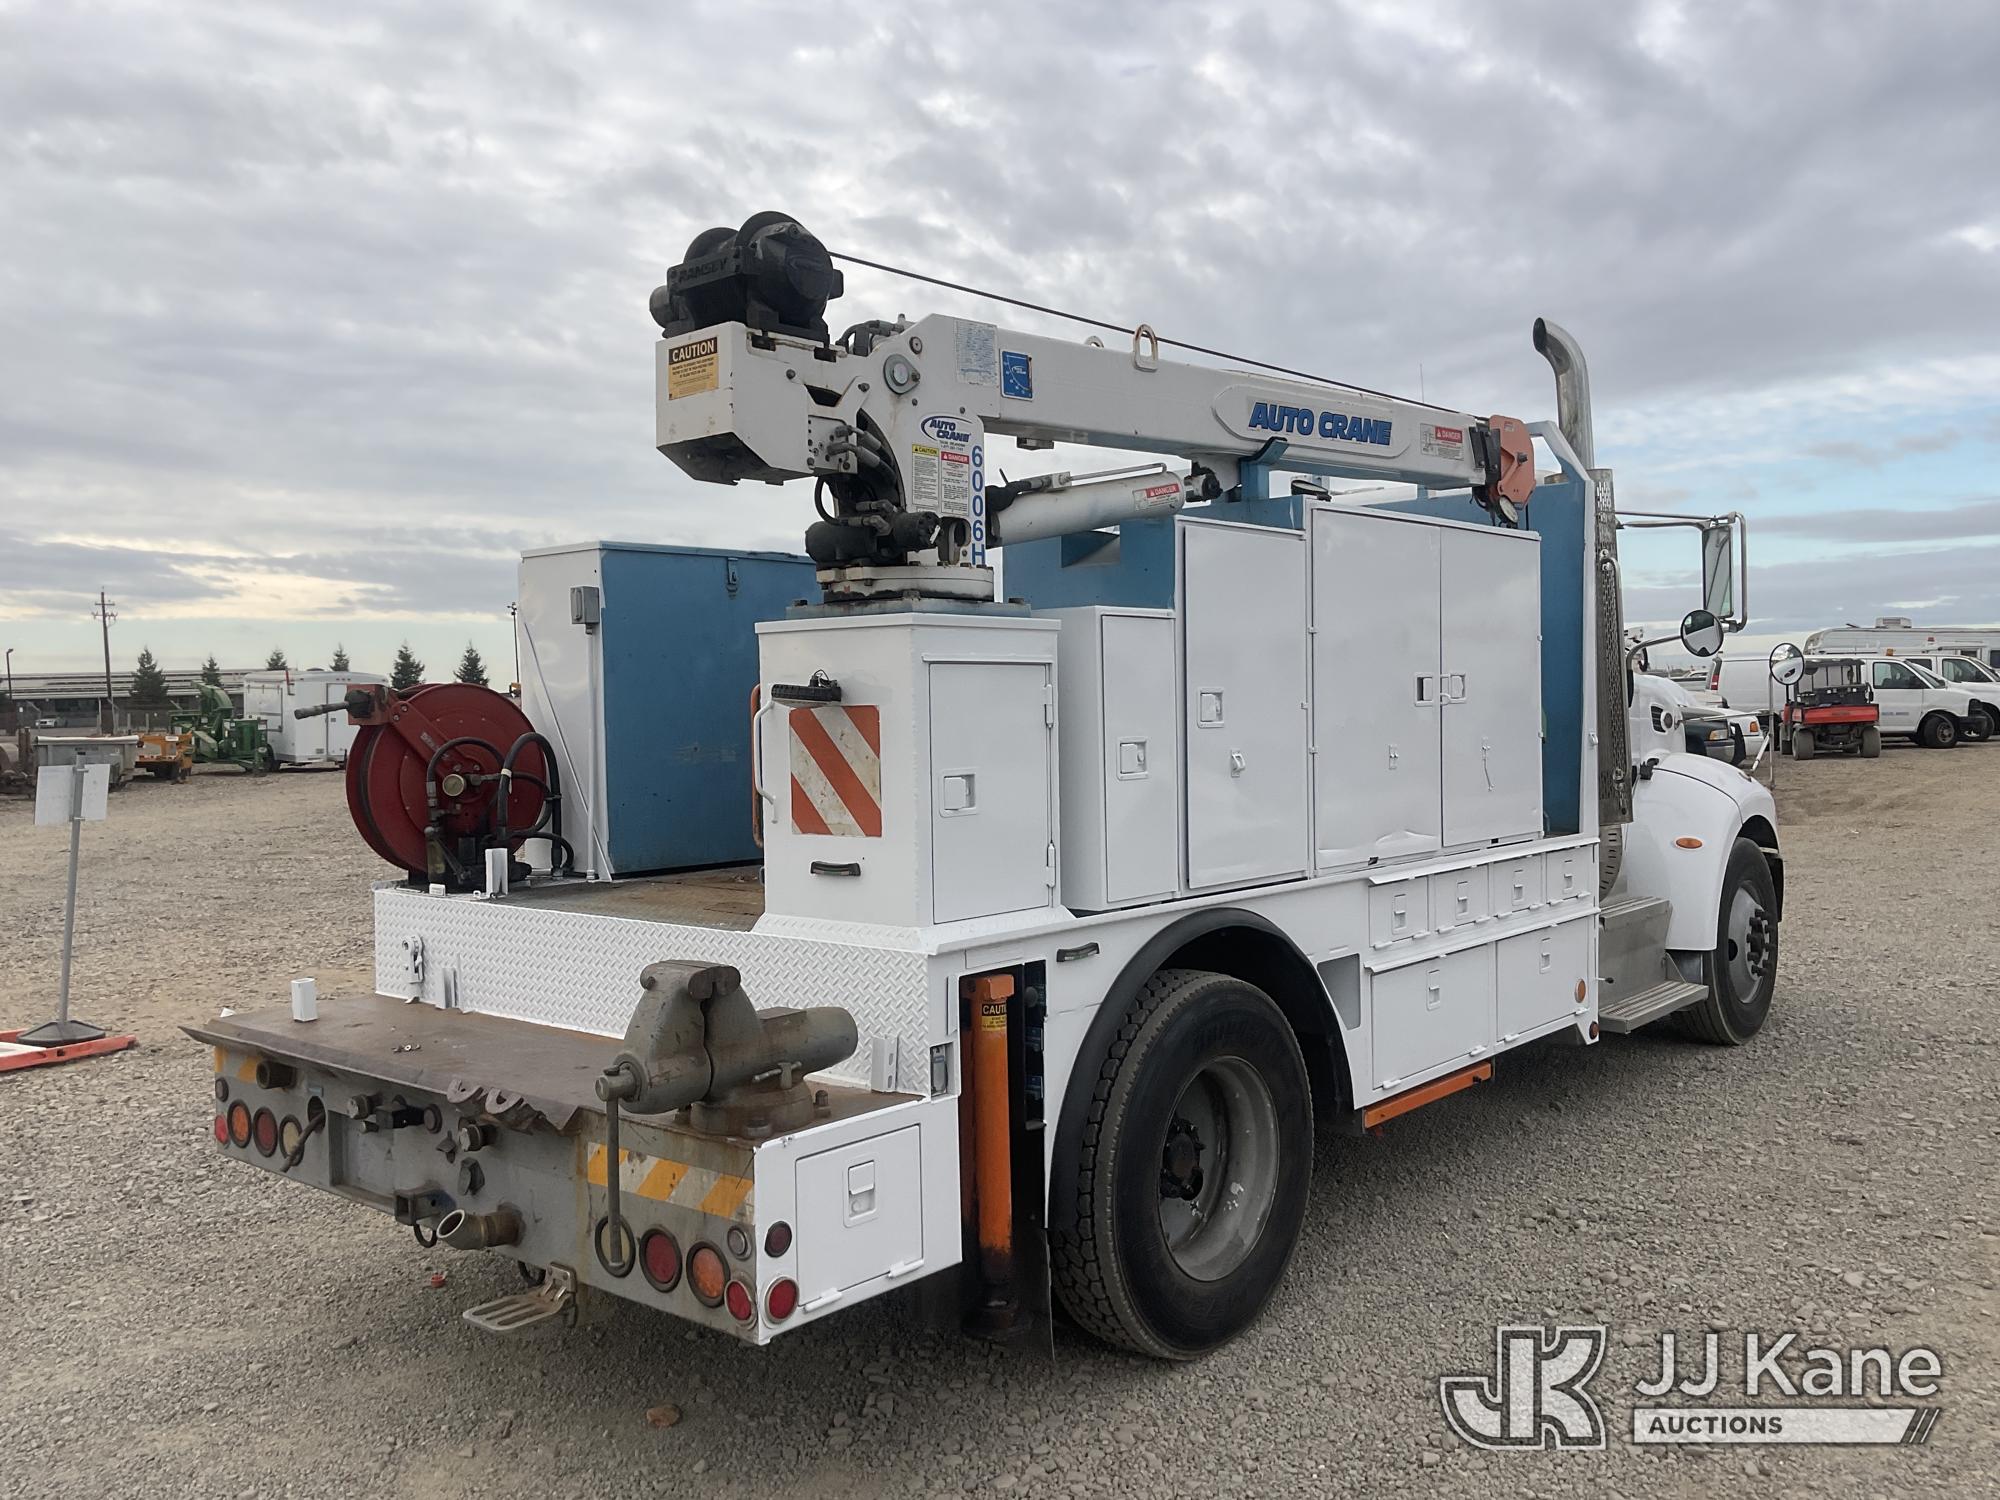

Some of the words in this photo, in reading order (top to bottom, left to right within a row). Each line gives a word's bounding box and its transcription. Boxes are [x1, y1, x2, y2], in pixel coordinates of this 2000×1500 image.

[672, 340, 714, 362] CAUTION
[929, 420, 956, 431] AUTO
[1249, 402, 1314, 436] AUTO
[1318, 412, 1392, 445] CRANE
[936, 430, 970, 442] CRANE
[1441, 429, 1461, 440] DANGER
[947, 455, 968, 463] DANGER
[972, 445, 986, 565] 6006H
